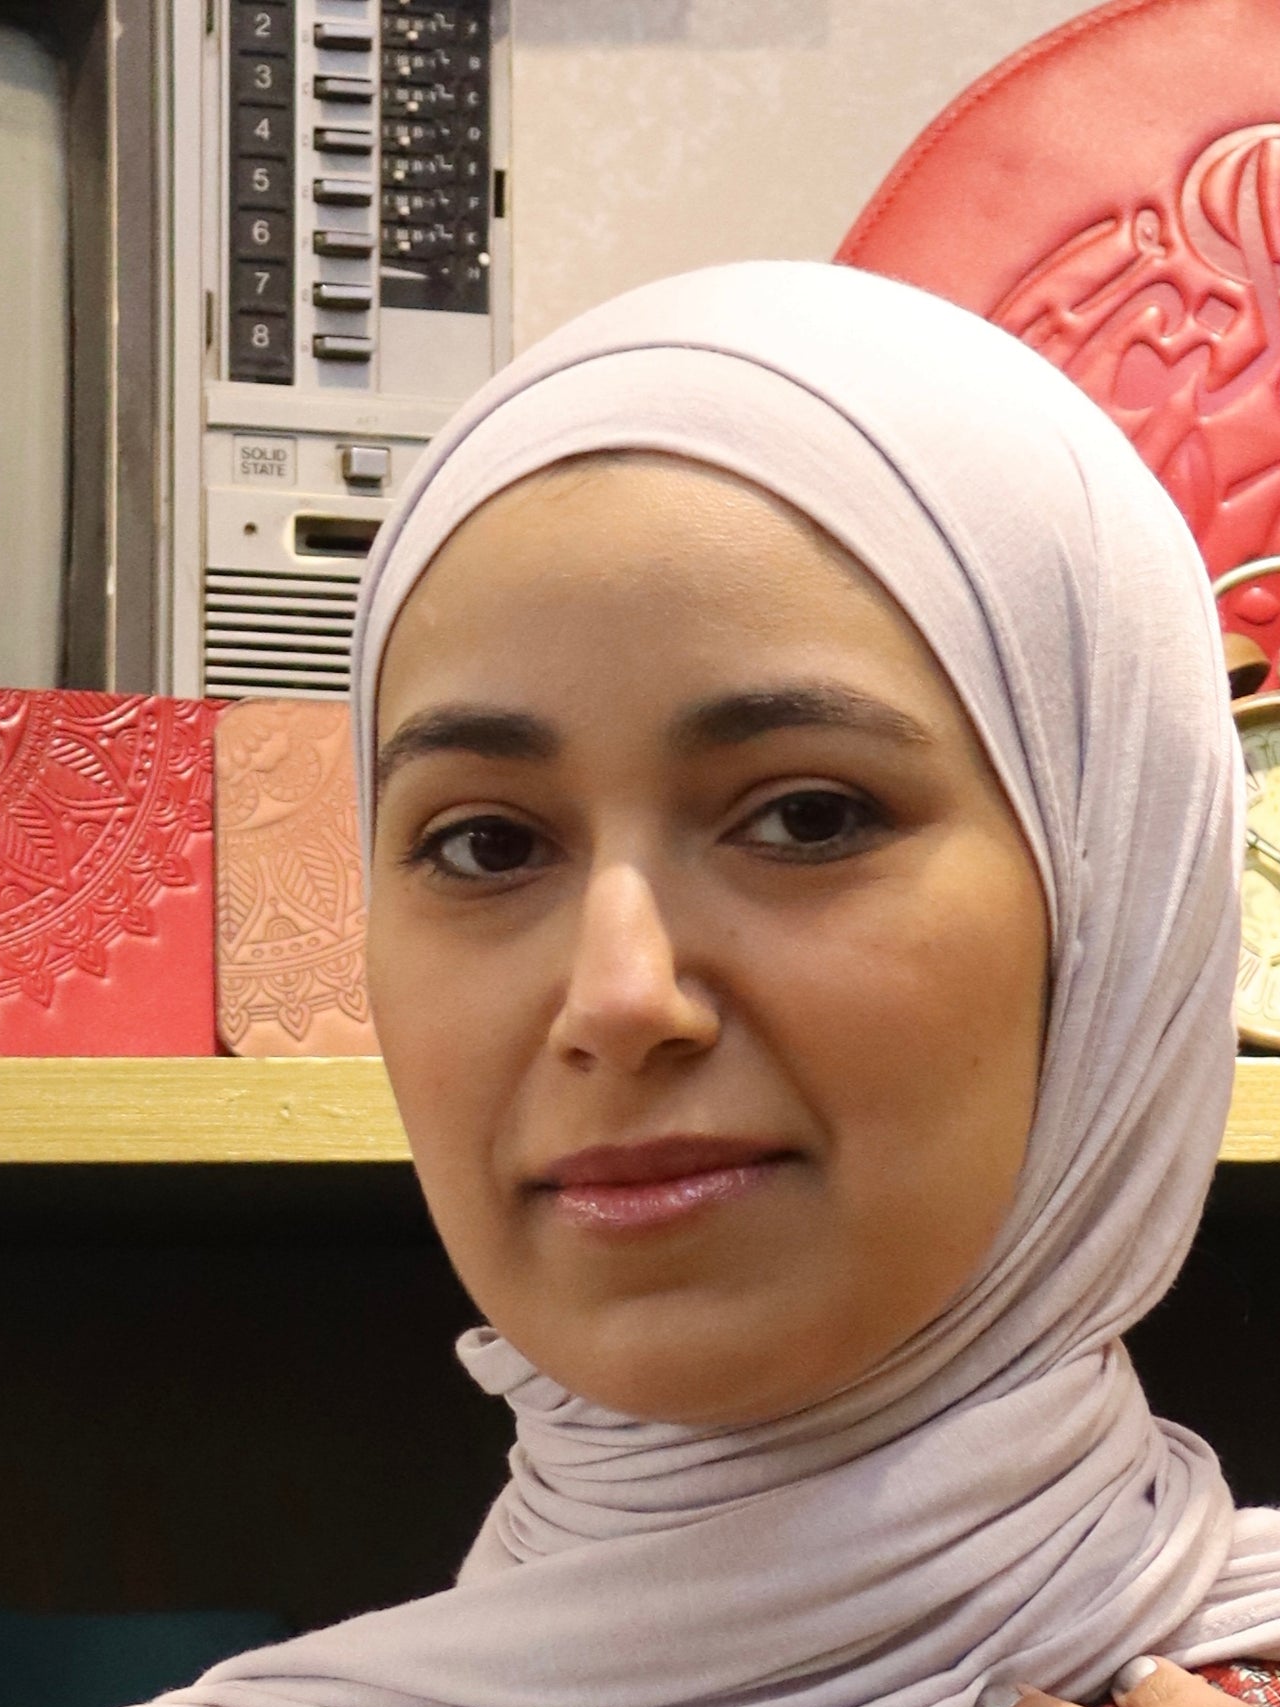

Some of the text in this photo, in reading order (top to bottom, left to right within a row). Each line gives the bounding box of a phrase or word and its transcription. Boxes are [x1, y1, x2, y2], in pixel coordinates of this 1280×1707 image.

[255, 12, 272, 38] 2
[255, 64, 272, 89] 3
[254, 118, 271, 141] 4
[252, 168, 270, 192] 5
[251, 219, 270, 245] 6
[254, 272, 270, 295] 7
[252, 324, 269, 348] 8
[240, 446, 288, 462] SOLID
[240, 461, 287, 477] STATE
